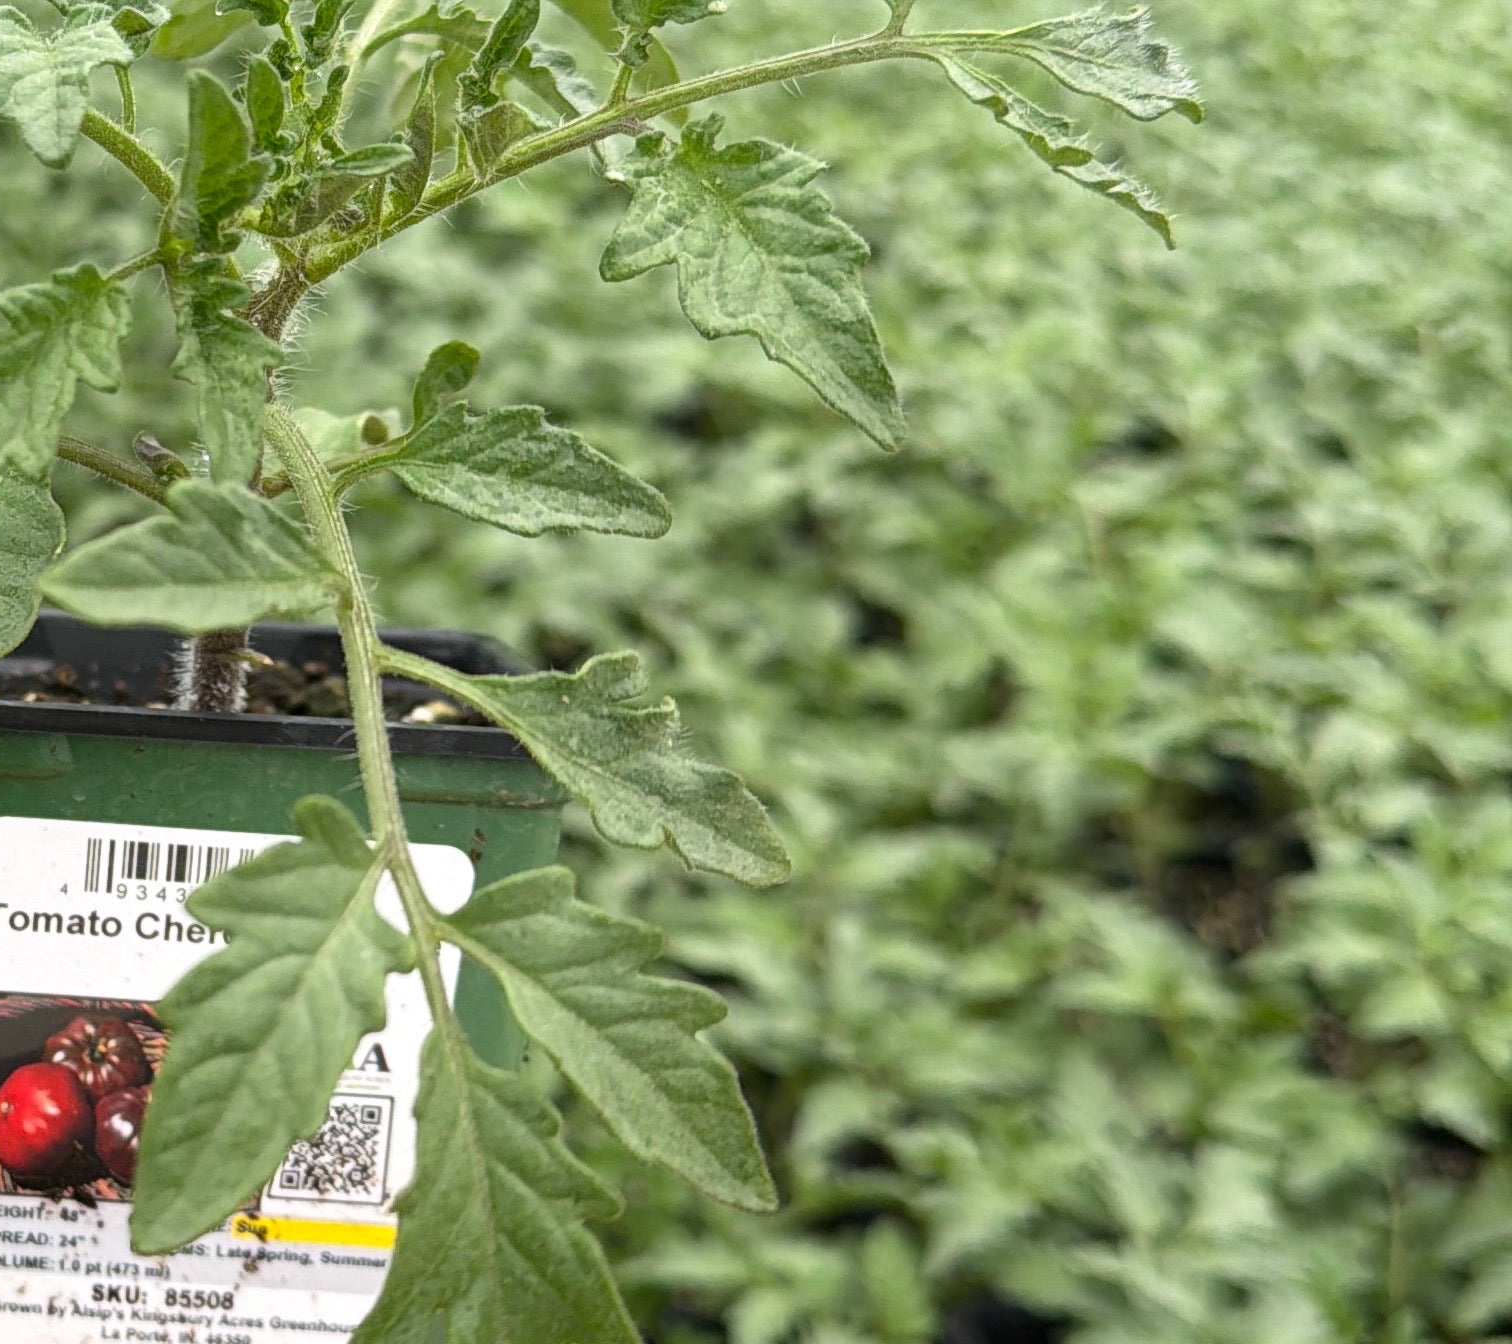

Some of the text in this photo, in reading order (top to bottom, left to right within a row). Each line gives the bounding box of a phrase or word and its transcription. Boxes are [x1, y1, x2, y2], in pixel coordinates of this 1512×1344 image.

[116, 883, 187, 903] 9343
[216, 1244, 251, 1259] Late
[91, 1283, 234, 1310] SKU: 85508
[219, 1312, 264, 1329] Acres
[101, 1326, 120, 1340] La
